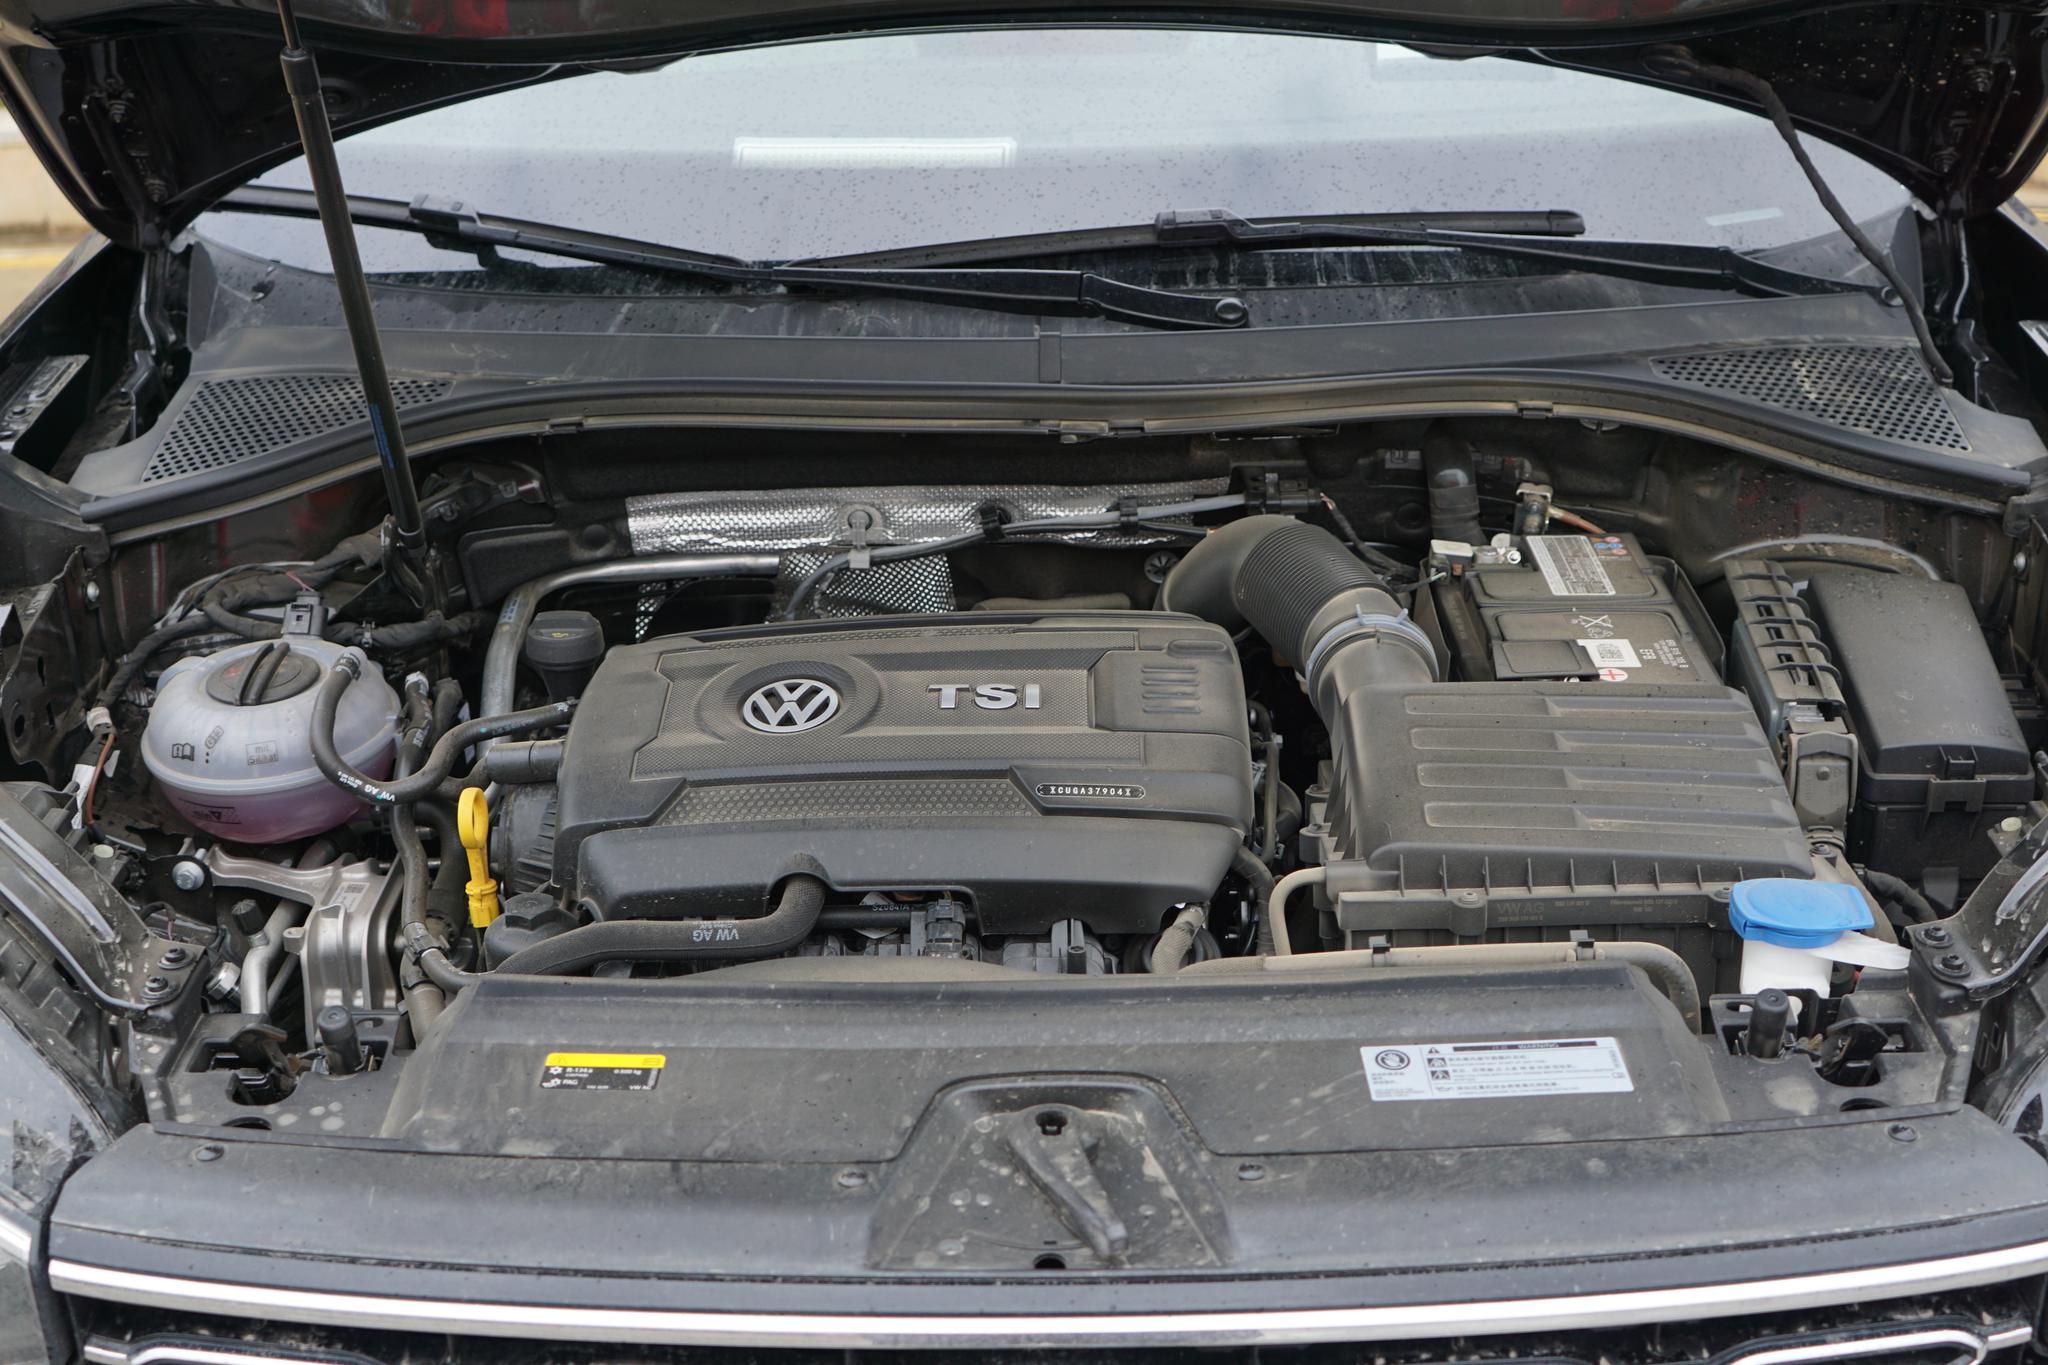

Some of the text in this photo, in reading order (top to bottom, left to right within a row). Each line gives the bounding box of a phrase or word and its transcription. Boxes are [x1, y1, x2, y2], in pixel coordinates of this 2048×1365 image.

[927, 683, 1041, 709] TSI
[692, 928, 740, 943] VW AG
